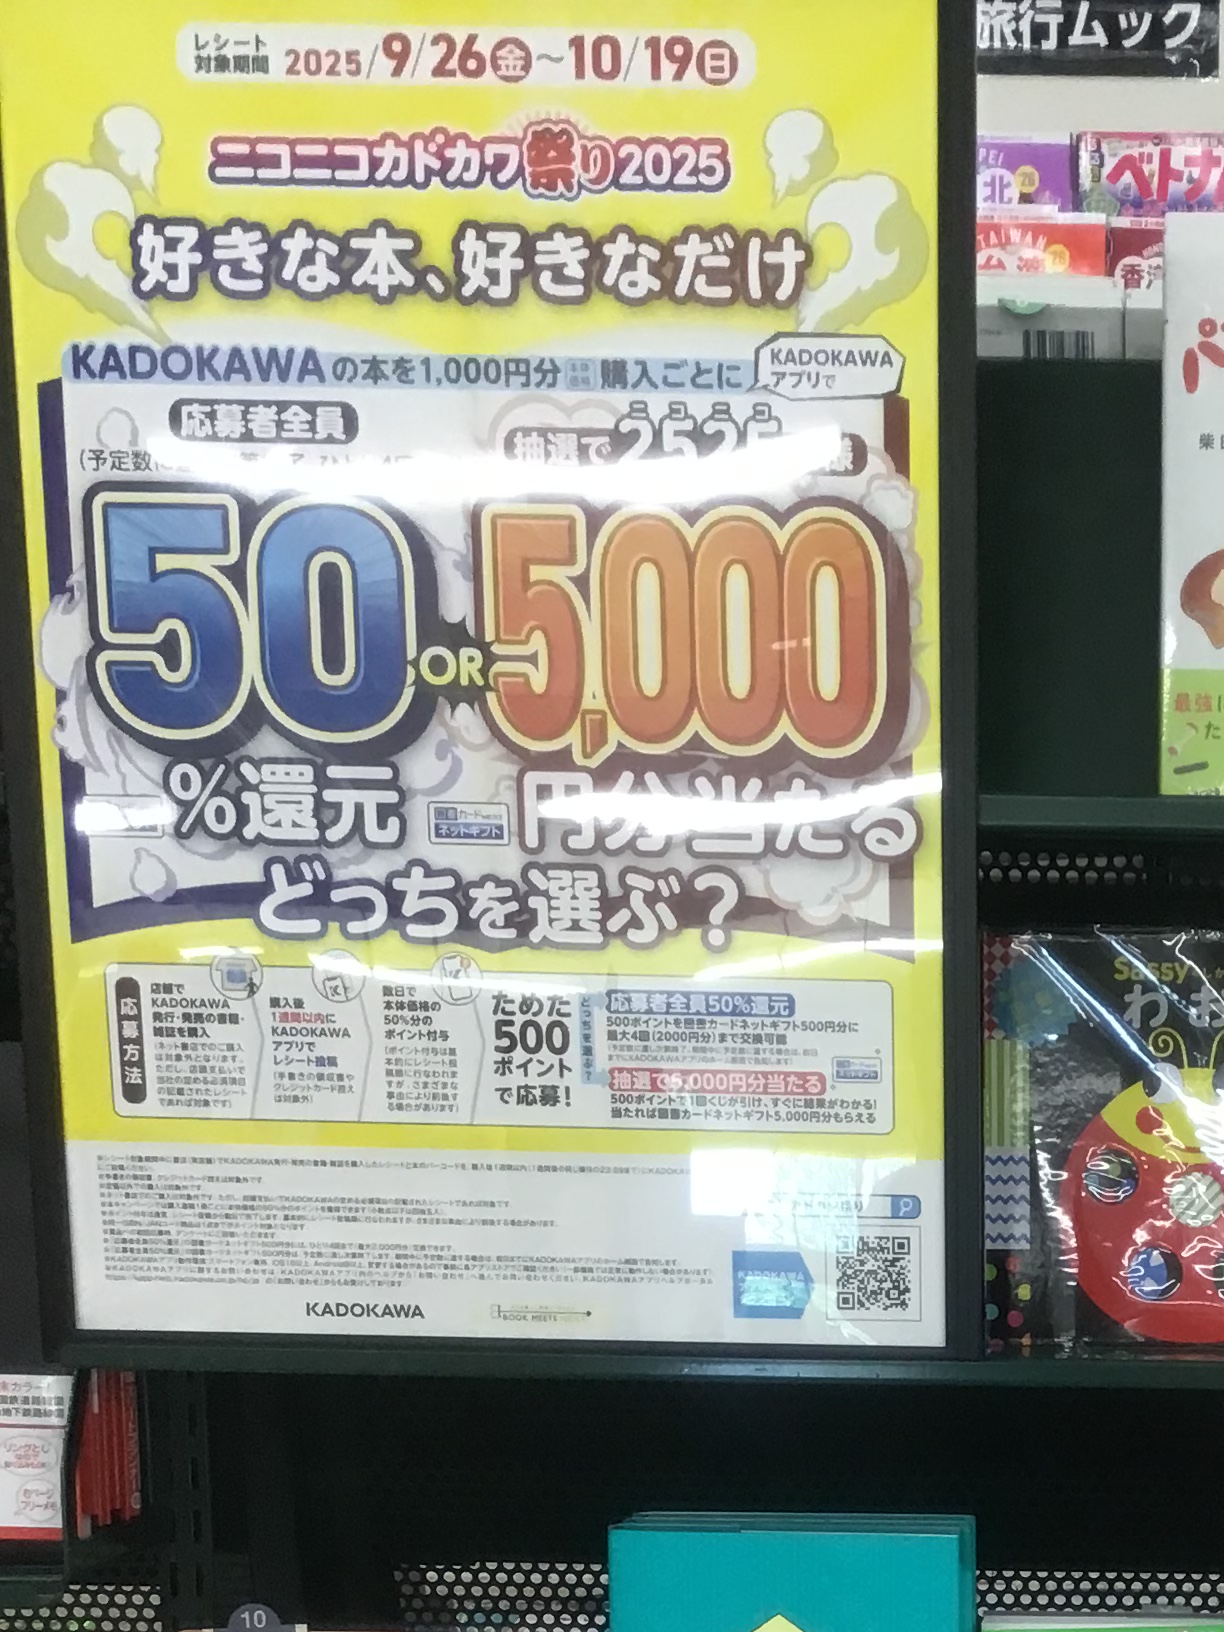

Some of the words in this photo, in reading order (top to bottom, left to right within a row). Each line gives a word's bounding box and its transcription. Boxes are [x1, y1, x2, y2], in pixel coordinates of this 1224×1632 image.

[193, 33, 269, 53] レシート
[194, 53, 270, 75] 対象期間
[212, 120, 730, 198] ニコニコカドカワ祭り2025
[136, 222, 808, 304] 好きな本、好きなだけ
[769, 347, 895, 371] KADOKAWA
[770, 371, 836, 391] アプリで
[180, 404, 349, 442] 応募者全員
[92, 492, 412, 742] 50
[477, 495, 888, 767] 5,000
[418, 650, 483, 688] OR
[168, 762, 401, 845] %還元
[523, 768, 920, 858] 円分当たる
[259, 863, 741, 947] どっちを選ぶ?
[1114, 955, 1192, 982] Sassy
[150, 982, 185, 995] 店舗で
[382, 985, 417, 998] 数日で
[151, 997, 230, 1010] KADOKAWA
[270, 997, 305, 1010] 購入後
[383, 1000, 442, 1013] 本体価格の
[491, 994, 572, 1018] ためた
[610, 993, 790, 1016] 応募者全員50%還元
[384, 1014, 433, 1027] 50%分の
[119, 998, 142, 1085] 応募方法
[271, 1026, 351, 1039] KADOKAWA
[384, 1028, 449, 1042] ポイント付与
[493, 1019, 571, 1056] 500
[272, 1040, 316, 1053] アプリで
[493, 1057, 573, 1079] ポイント
[498, 1084, 572, 1109] で応募!
[305, 1302, 426, 1320] KADOKAWA
[239, 1609, 268, 1630] 10
